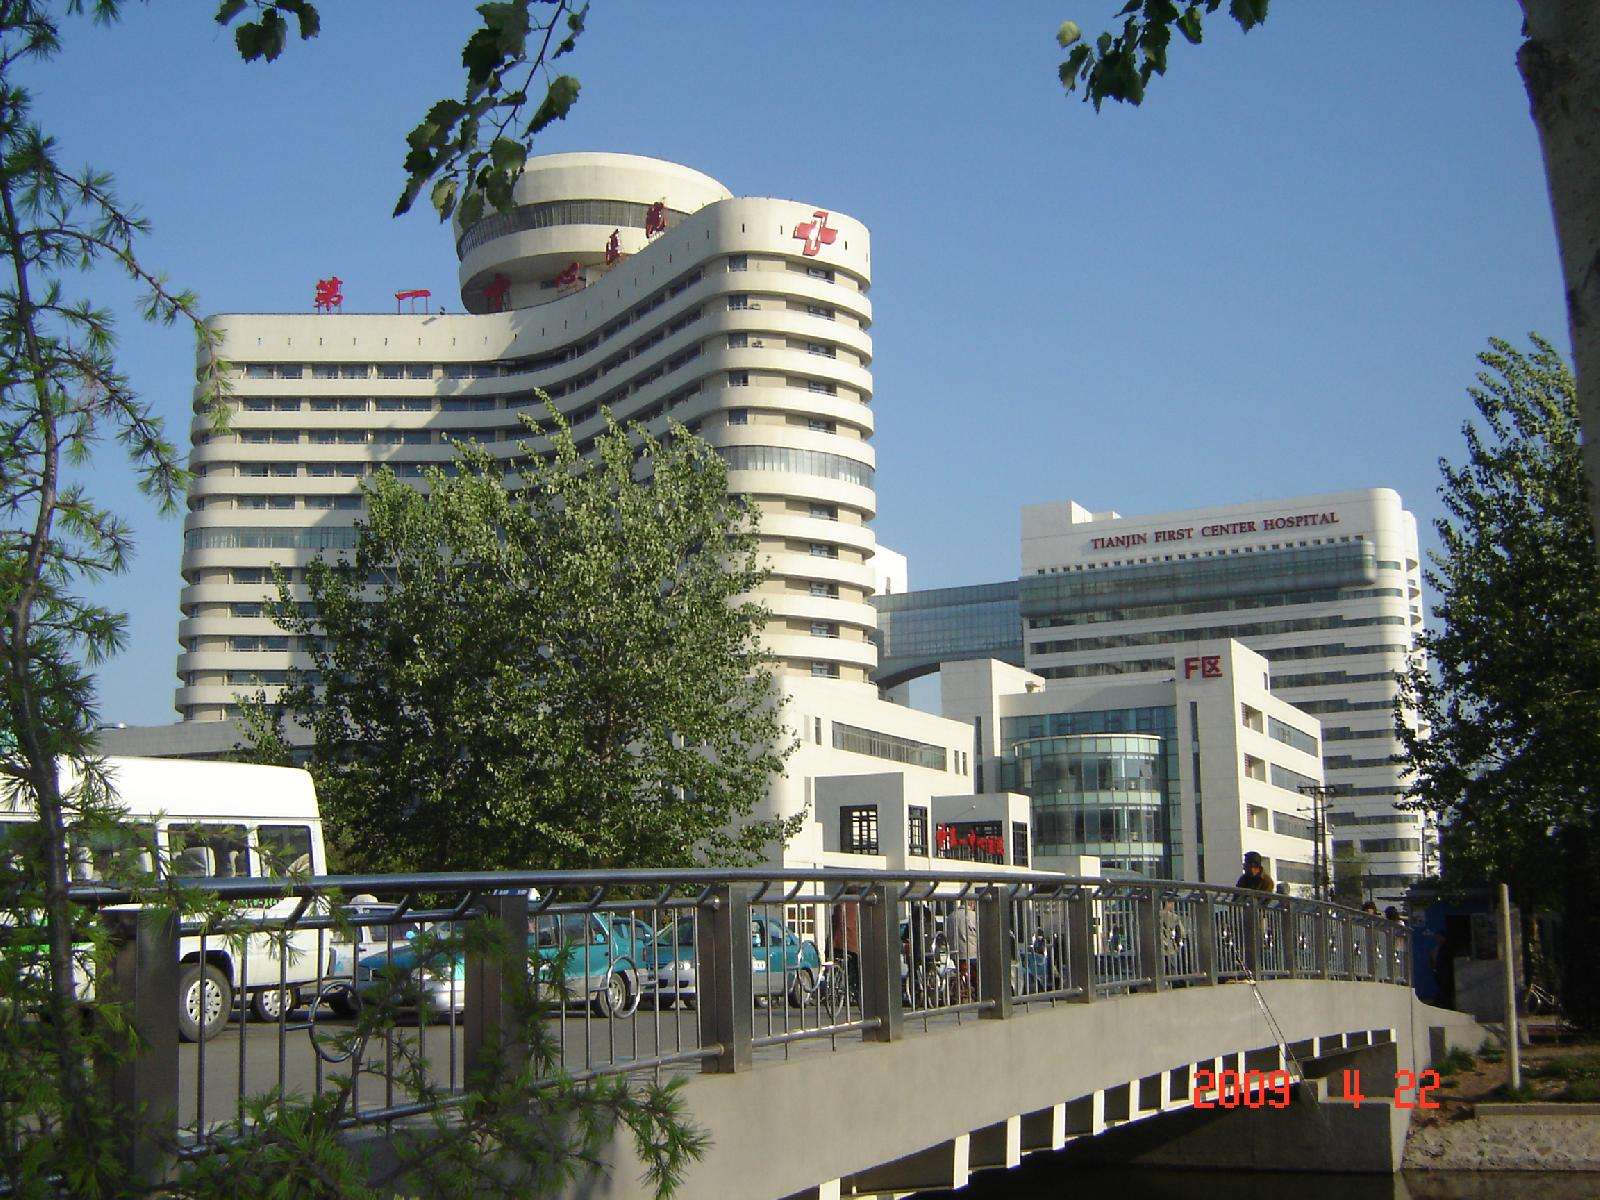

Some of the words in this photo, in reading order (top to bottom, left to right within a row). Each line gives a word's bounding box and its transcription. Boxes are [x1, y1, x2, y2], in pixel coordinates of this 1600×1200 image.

[1091, 532, 1147, 551] TIANJIN
[1155, 527, 1194, 543] FIRST
[1202, 521, 1257, 537] CENTER
[1263, 512, 1339, 530] HOSPITAL
